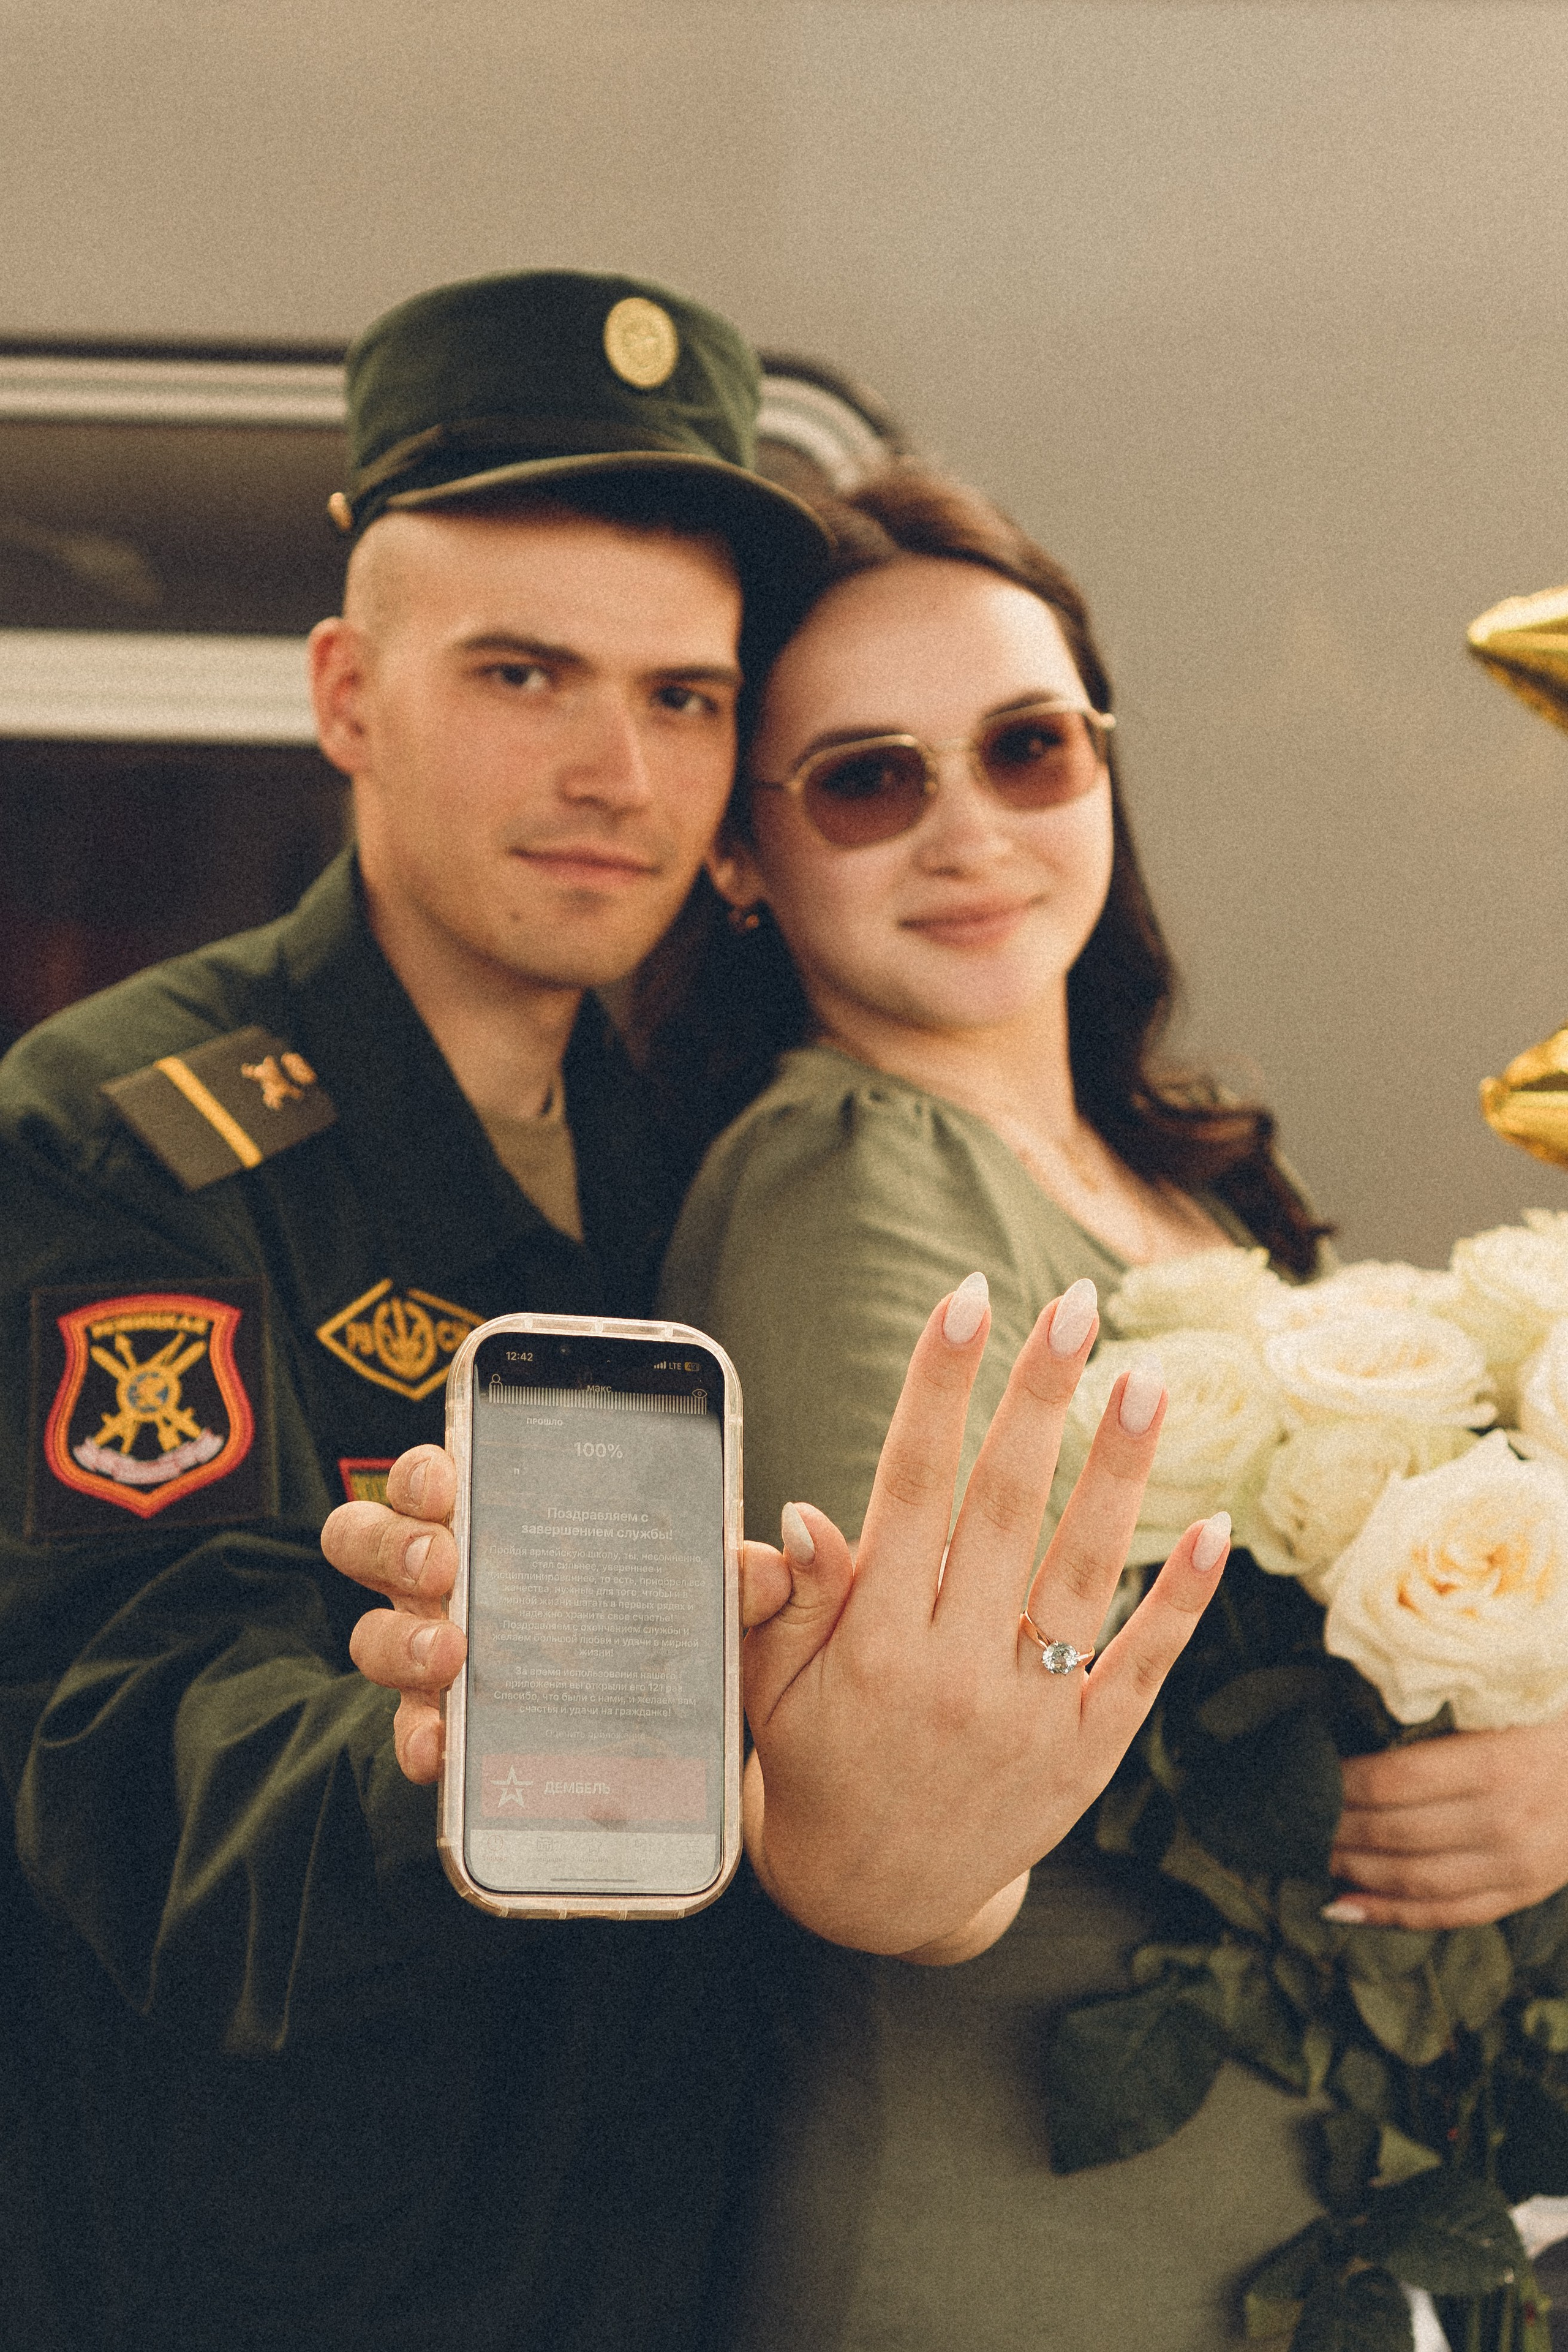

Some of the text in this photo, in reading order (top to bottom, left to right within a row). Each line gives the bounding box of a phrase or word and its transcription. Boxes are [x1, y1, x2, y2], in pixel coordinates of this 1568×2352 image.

[506, 1351, 533, 1362] 12:42
[669, 1362, 682, 1370] LTE
[587, 1384, 612, 1393] макс
[526, 1417, 563, 1427] прошло
[574, 1442, 624, 1458] 100%
[548, 1507, 649, 1523] Поздравляем с
[521, 1524, 673, 1541] завершением службы!
[490, 1545, 703, 1564] Пройдя армейскую школу, ты, несомненно,
[557, 1562, 599, 1572] сильнее,
[602, 1564, 654, 1574] увереннее
[613, 1577, 637, 1586] есть,
[640, 1577, 687, 1588] приобрел
[505, 1585, 551, 1595] качества,
[555, 1586, 594, 1595] нужные
[616, 1589, 639, 1598] того,
[499, 1595, 537, 1605] мирной
[619, 1600, 654, 1610] первых
[657, 1602, 685, 1611] рядах
[519, 1610, 563, 1618] надежно
[565, 1611, 605, 1620] хранить
[632, 1614, 673, 1623] счастье!
[503, 1620, 570, 1631] Поздравляем
[581, 1624, 641, 1634] окончанием
[643, 1626, 680, 1635] службы
[492, 1634, 531, 1642] желаем
[533, 1633, 577, 1643] большой
[579, 1636, 612, 1645] любви
[622, 1638, 651, 1647] удачи
[662, 1638, 699, 1649] мирной
[579, 1648, 614, 1657] жизни!
[515, 1666, 527, 1676] За
[530, 1668, 561, 1678] время
[563, 1670, 638, 1679] использования
[505, 1680, 567, 1689] приложения
[585, 1683, 627, 1692] открыли
[648, 1683, 663, 1692] 121
[666, 1685, 685, 1694] раз.
[494, 1691, 539, 1702] Спасибо,
[562, 1692, 587, 1702] были
[598, 1695, 626, 1705] нами,
[519, 1705, 558, 1714] счастья
[569, 1707, 598, 1716] удачи
[615, 1708, 671, 1717] гражданке!
[544, 1781, 611, 1795] ДЕМБЕЛЬ
